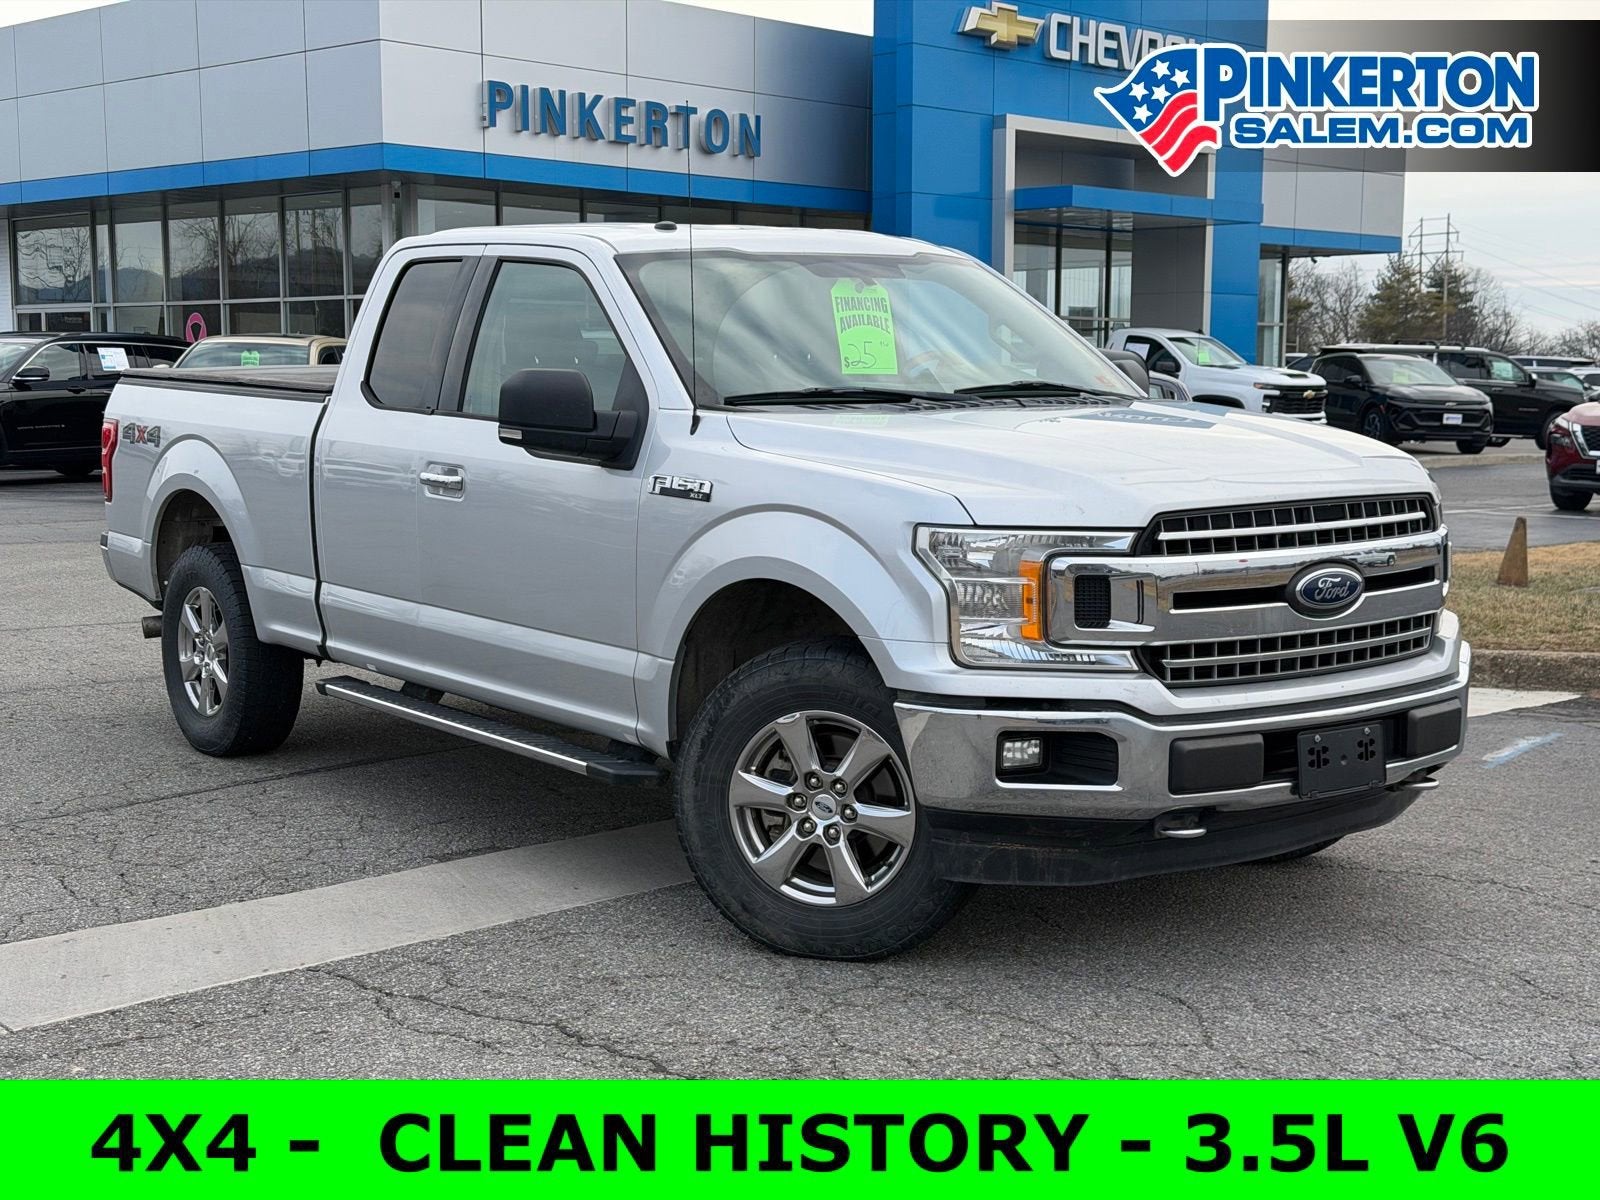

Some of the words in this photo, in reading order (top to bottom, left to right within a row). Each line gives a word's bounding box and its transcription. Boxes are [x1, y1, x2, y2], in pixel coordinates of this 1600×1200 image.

[481, 80, 761, 157] PINKERTON
[834, 296, 888, 313] FINANCING
[840, 314, 891, 334] AVAILABLE
[1314, 577, 1350, 600] Ford
